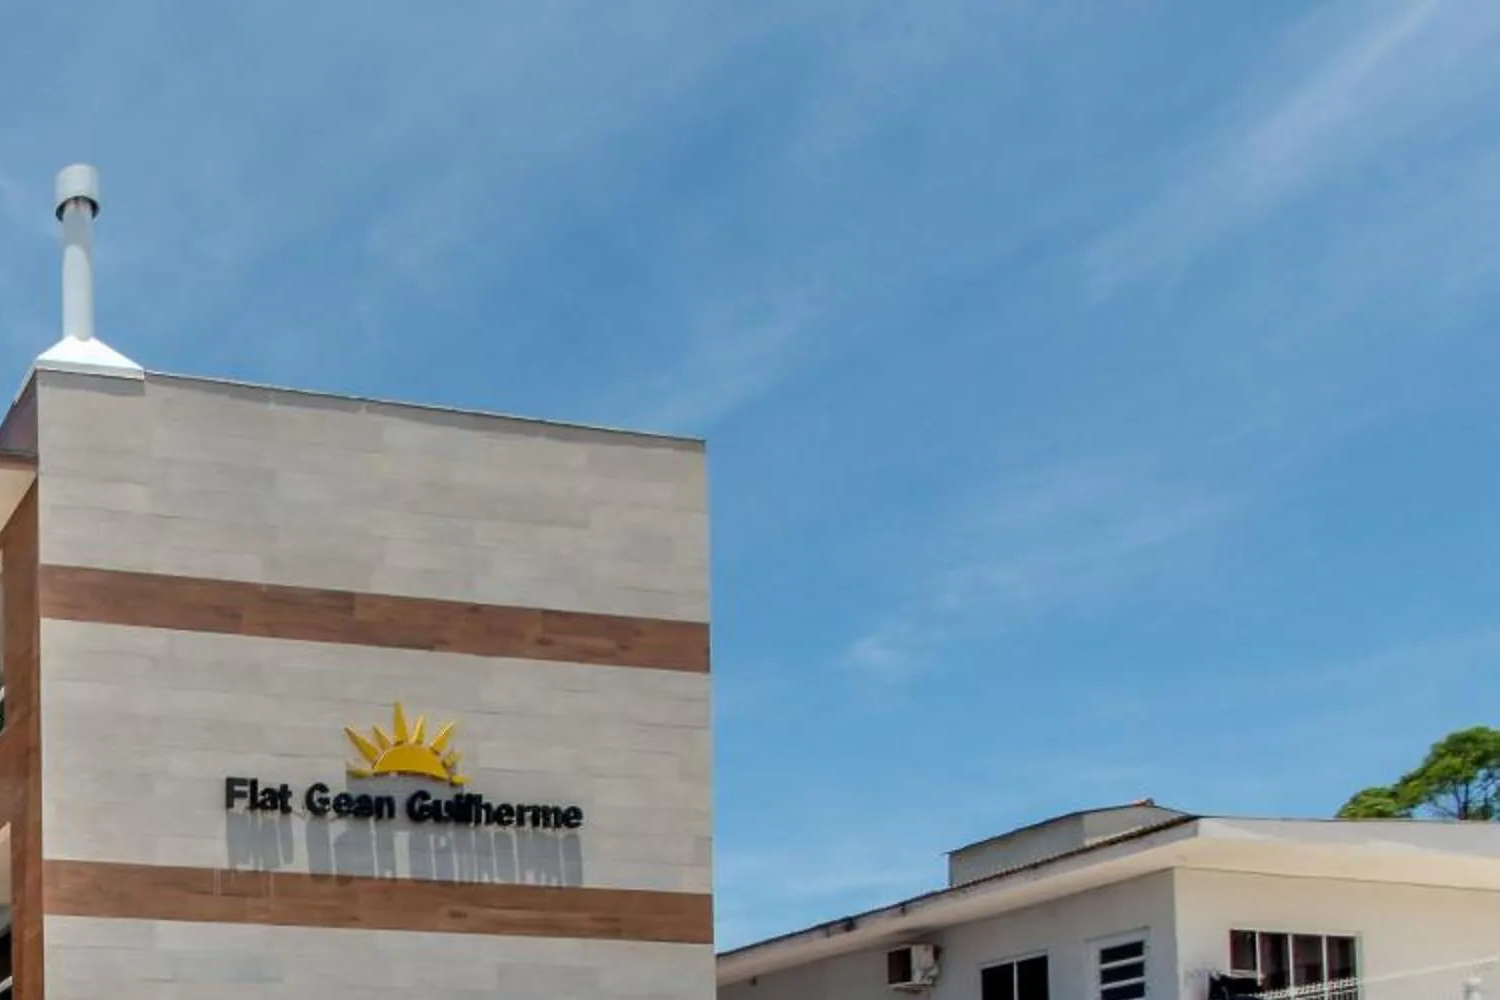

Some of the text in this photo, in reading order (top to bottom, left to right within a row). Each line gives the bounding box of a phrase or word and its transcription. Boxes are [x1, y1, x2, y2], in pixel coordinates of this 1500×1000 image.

[225, 777, 584, 830] Flat Gean Guilherme
